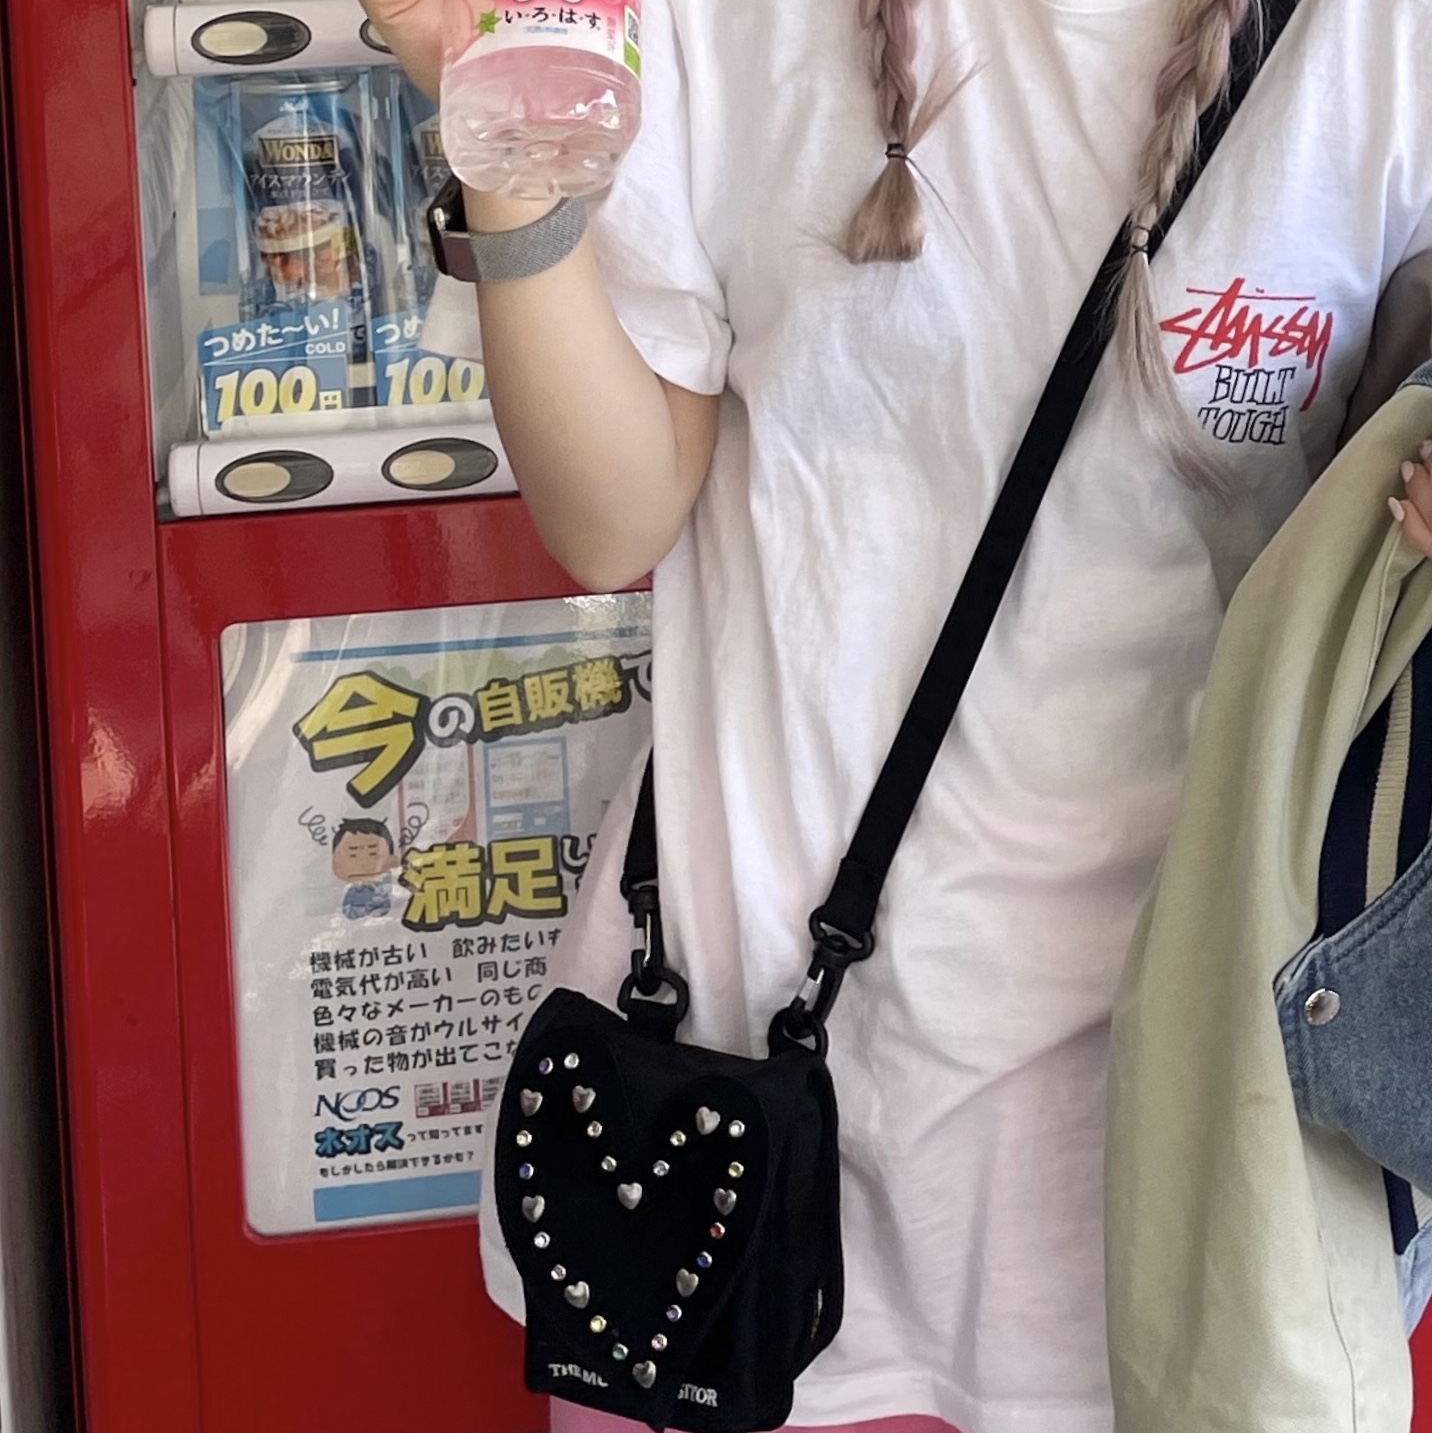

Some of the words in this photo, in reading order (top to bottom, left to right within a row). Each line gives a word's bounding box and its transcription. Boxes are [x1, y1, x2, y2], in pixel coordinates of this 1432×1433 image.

[265, 137, 335, 167] WONDA
[305, 342, 346, 355] COLD
[1208, 364, 1297, 405] BUILT
[1198, 405, 1290, 446] TOUGH
[402, 830, 598, 928] 満足し
[309, 942, 429, 974] 機械が古い
[310, 966, 453, 1000] 電気代が高い
[476, 956, 547, 984] 同じ商
[313, 1011, 525, 1055] 機械の音がウルサイ
